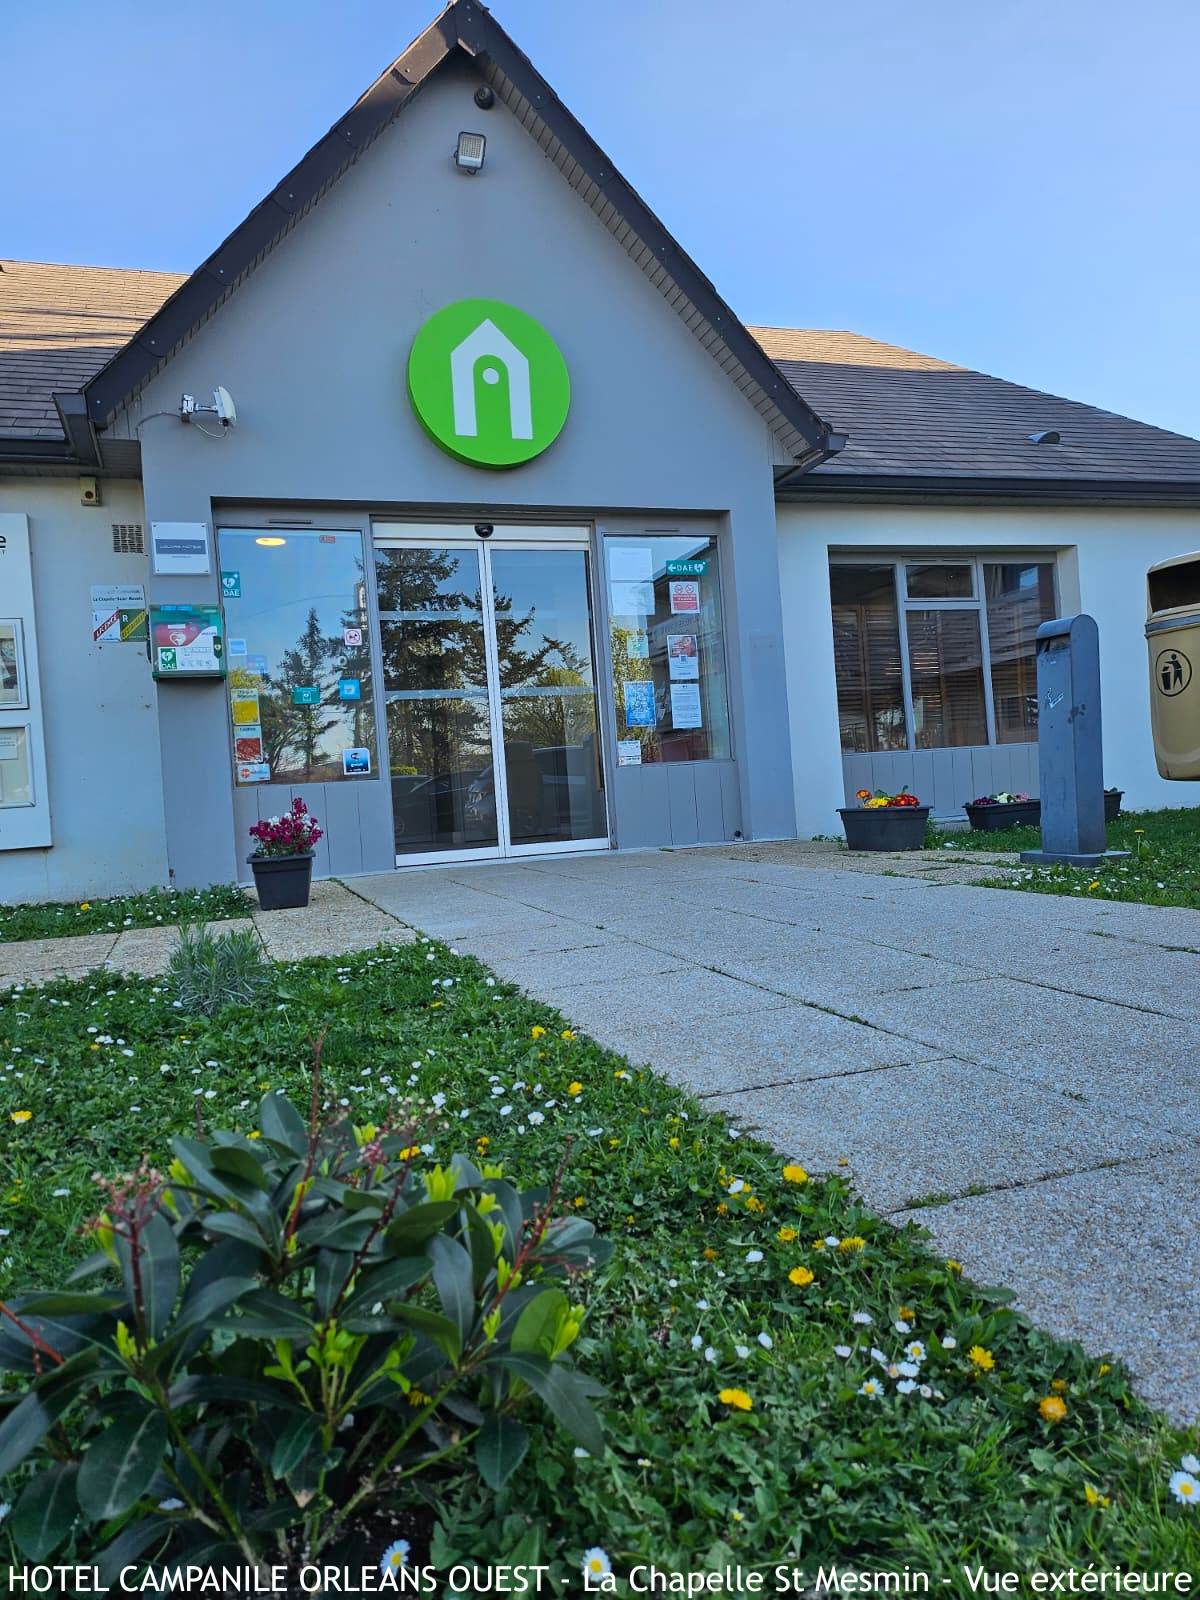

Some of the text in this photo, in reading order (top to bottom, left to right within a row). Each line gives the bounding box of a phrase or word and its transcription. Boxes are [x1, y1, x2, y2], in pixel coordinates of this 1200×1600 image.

[677, 564, 694, 572] DAE
[122, 615, 129, 623] R
[96, 614, 118, 637] LICENCE
